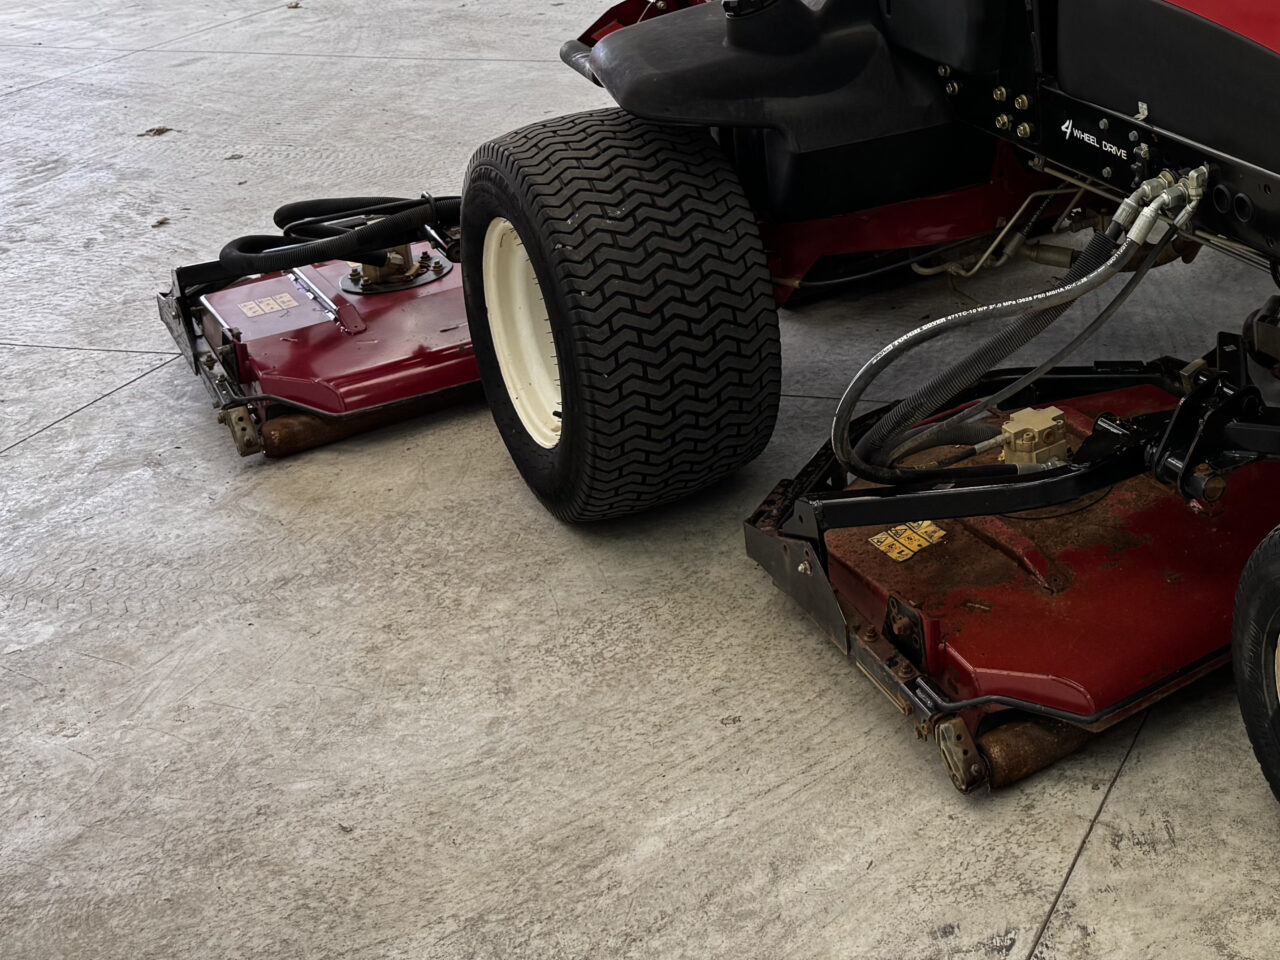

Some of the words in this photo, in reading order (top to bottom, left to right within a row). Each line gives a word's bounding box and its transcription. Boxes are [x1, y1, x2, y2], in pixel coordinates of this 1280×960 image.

[1060, 119, 1073, 140] 4
[1072, 127, 1100, 148] WHEEL
[1101, 140, 1128, 160] DRIVE
